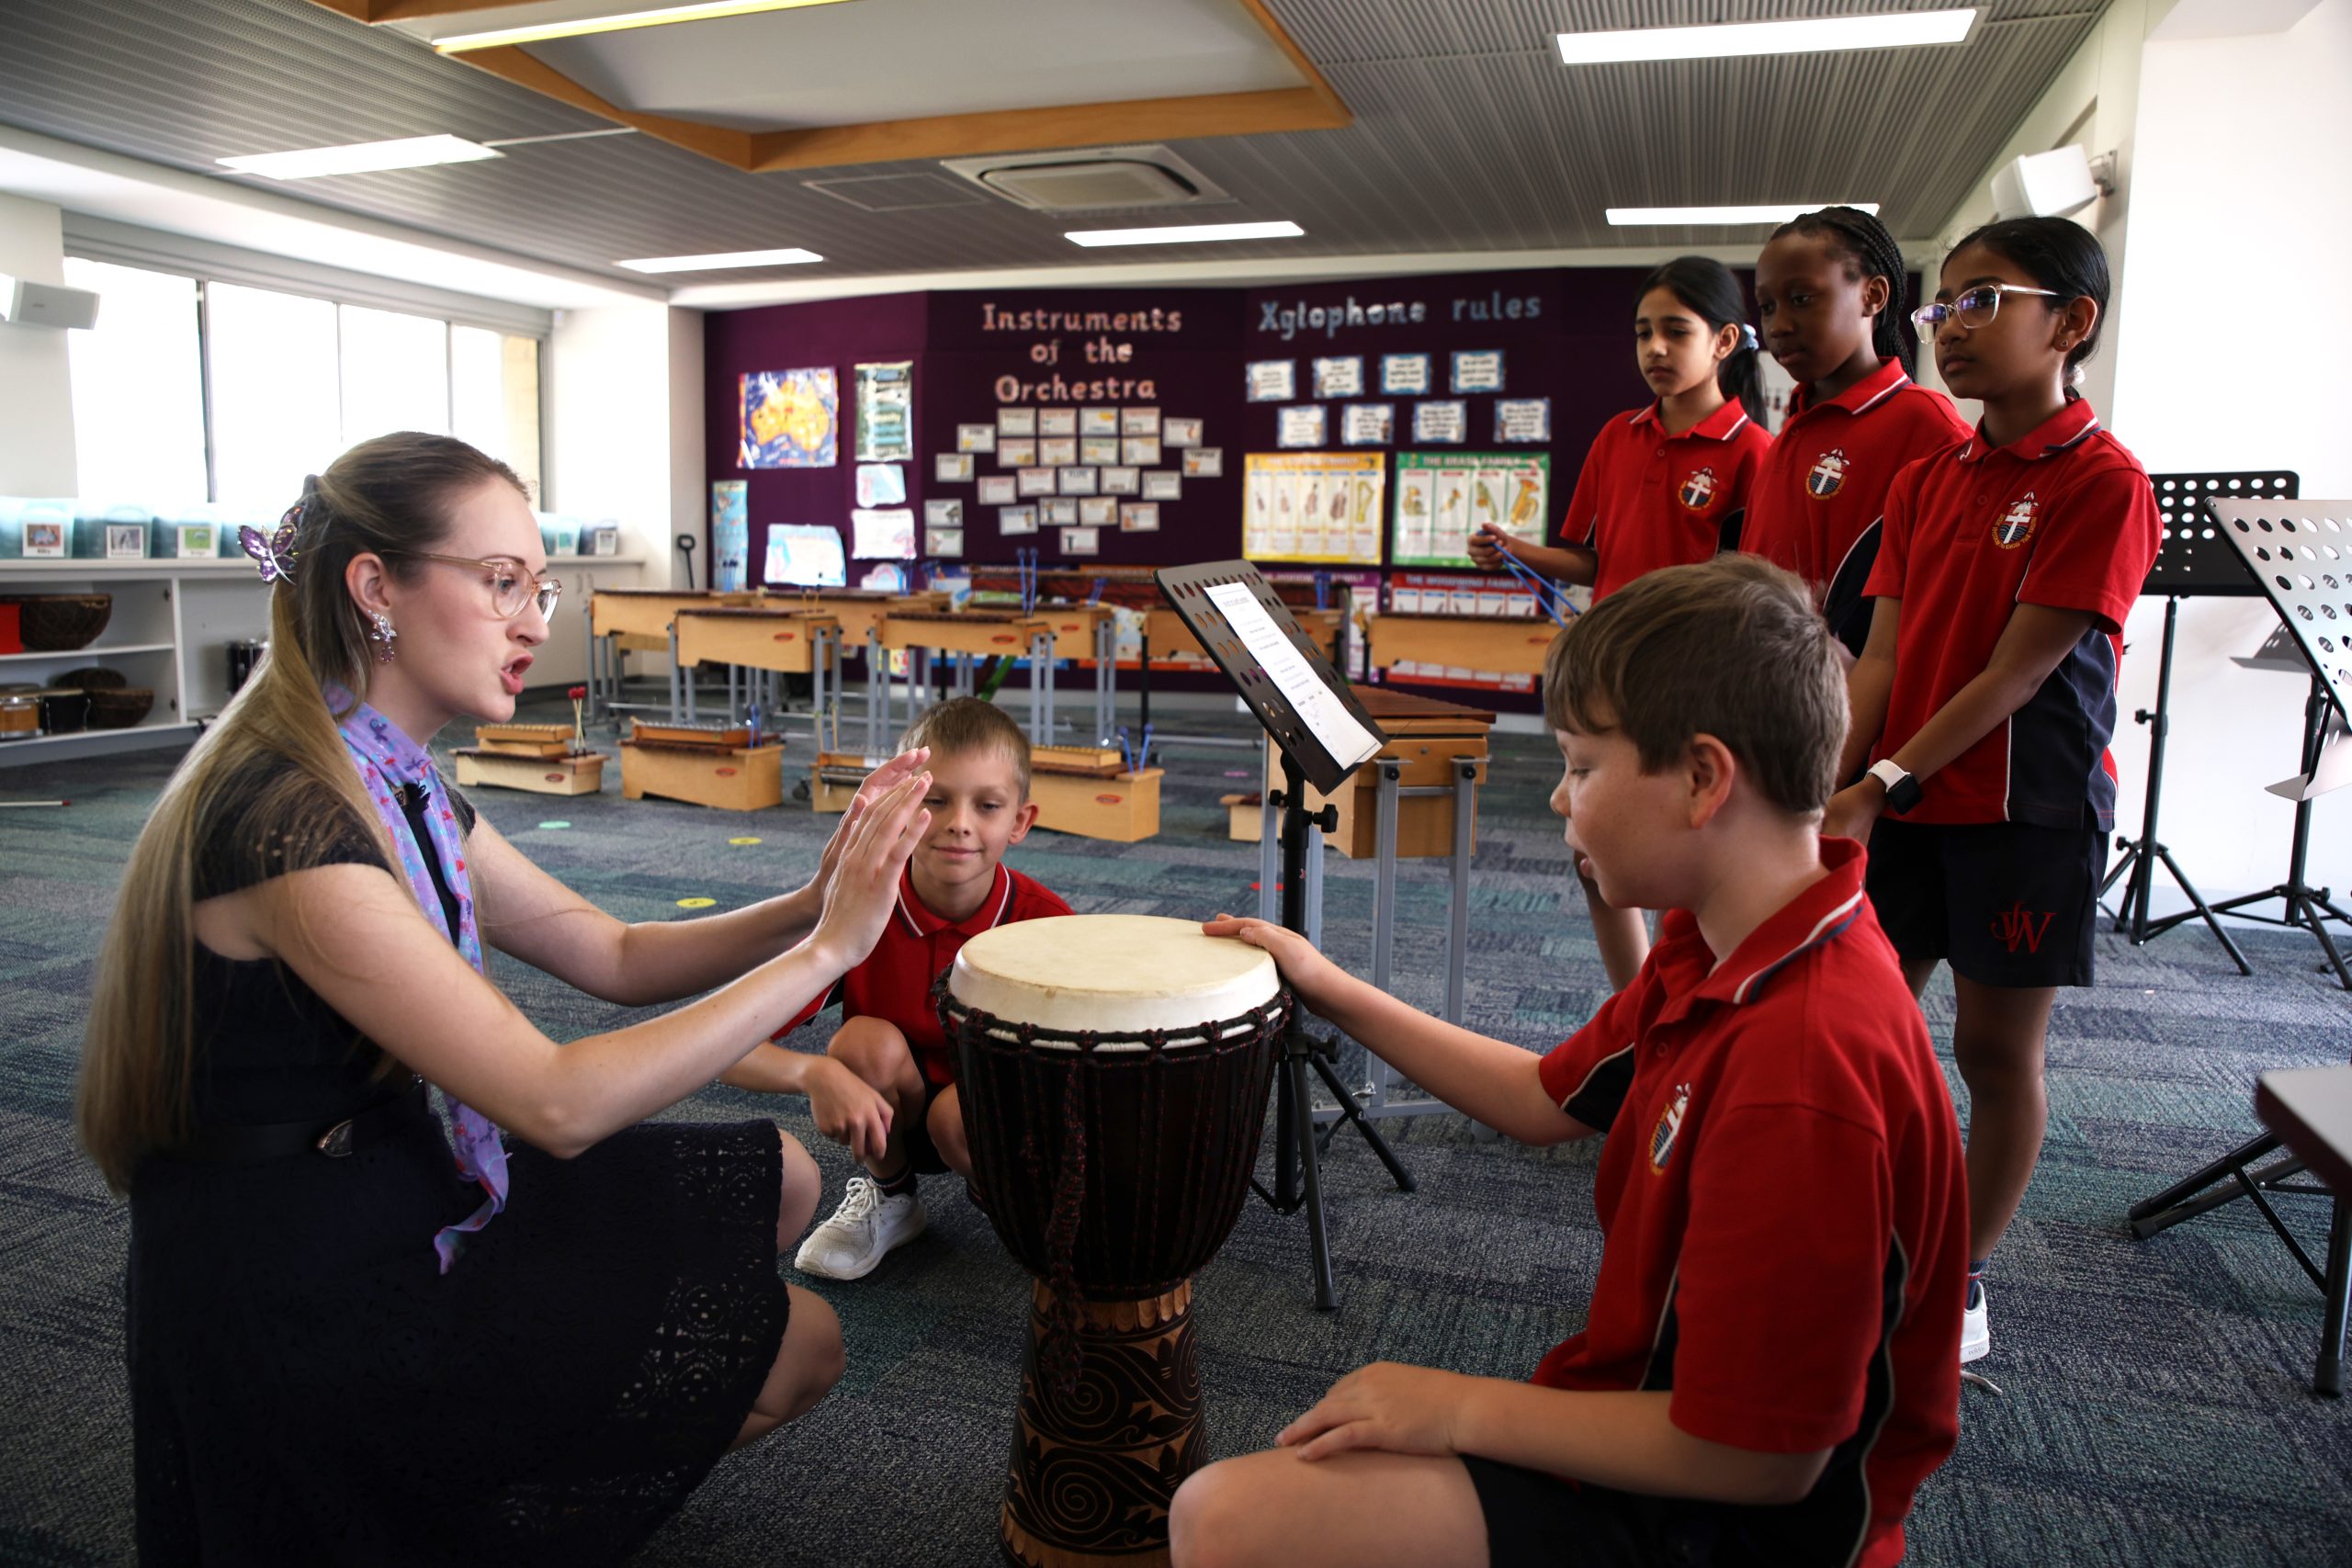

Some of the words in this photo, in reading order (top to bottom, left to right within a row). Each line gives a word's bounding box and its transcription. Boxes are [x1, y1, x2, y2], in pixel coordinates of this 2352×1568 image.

[982, 303, 1182, 332] Instruments
[1452, 290, 1542, 321] rules
[1030, 338, 1061, 366] of
[1084, 335, 1133, 364] the
[995, 373, 1157, 402] Orchestra
